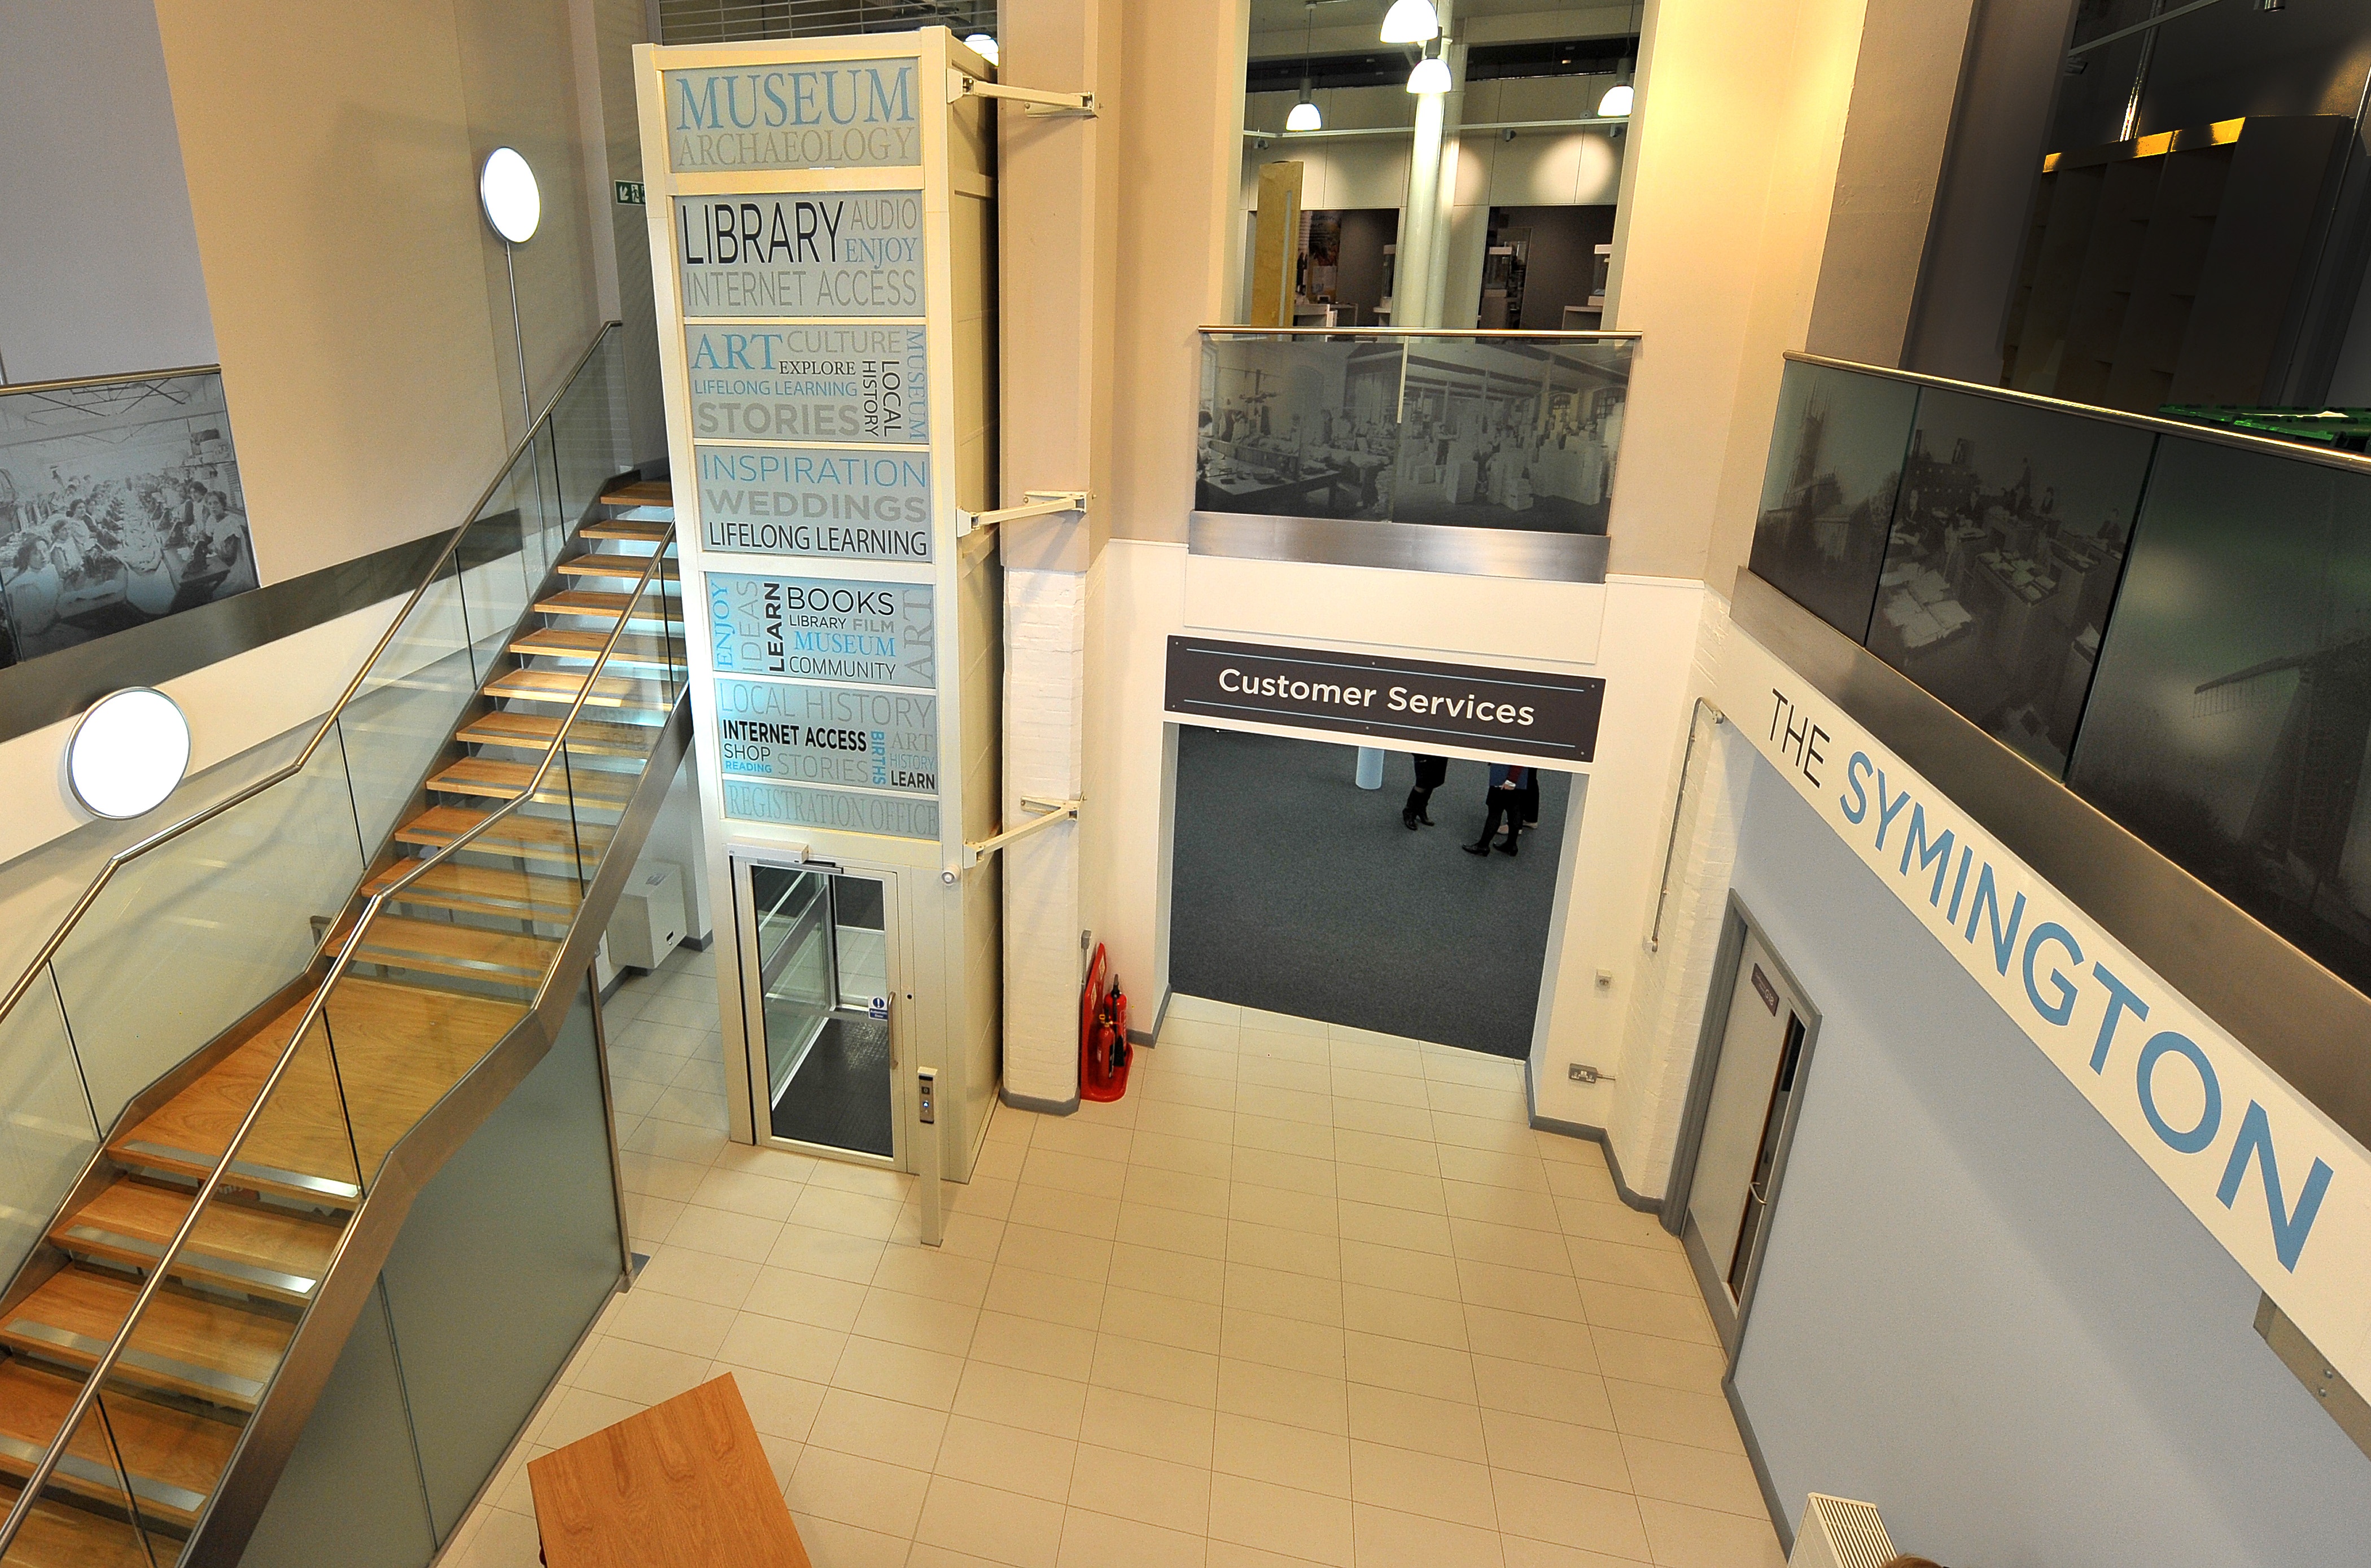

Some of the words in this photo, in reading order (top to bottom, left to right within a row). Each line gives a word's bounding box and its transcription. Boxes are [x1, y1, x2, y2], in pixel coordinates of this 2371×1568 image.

[676, 67, 915, 131] MUSEUM
[679, 126, 915, 167] ARCHAEOLOGY
[681, 200, 845, 265] LIBRARY
[850, 198, 917, 231] AUDIO
[845, 237, 917, 269] ENJOY
[686, 270, 807, 306] INTERNET
[817, 269, 917, 306] ACCESS
[692, 333, 782, 370] ART
[786, 330, 901, 354] CULTURE
[778, 360, 857, 376] EXPLORE
[905, 329, 926, 439] MUSEUM
[694, 379, 771, 395] LIFELONG
[775, 380, 858, 396] LEARNING
[862, 360, 879, 437] HISTORY
[881, 360, 902, 438] LOCAL
[697, 402, 860, 436] STORIES
[702, 454, 926, 488] INSPIRATION
[705, 488, 927, 523] WEDDINGS
[709, 522, 810, 550] LIFELONG
[816, 527, 927, 557] LEARNING
[786, 586, 895, 616] BOOKS
[711, 581, 734, 668] ENJOY
[738, 581, 763, 671] IDEAS
[763, 581, 785, 672] LEARN
[789, 614, 847, 630] LIBRARY
[852, 617, 895, 633] FILM
[904, 589, 934, 684] ART
[794, 630, 896, 658] MUSEUM
[789, 655, 896, 680] COMMUNITY
[720, 684, 795, 717] LOCAL
[806, 688, 933, 728] HISTORY
[1218, 668, 1377, 708] Customer
[1387, 686, 1535, 726] Services
[723, 719, 800, 746] INTERNET
[804, 727, 868, 752] ACCESS
[723, 743, 772, 762] SHOP
[890, 732, 934, 752] ART
[725, 760, 772, 774] READING
[778, 754, 868, 783] STORIES
[870, 730, 886, 785] BIRTHS
[889, 753, 934, 771] HISTORY
[890, 769, 936, 790] LEARN
[729, 785, 867, 827] REGISTRATION
[871, 800, 938, 836] OFFICE
[1771, 687, 1831, 789] THE
[1839, 751, 2335, 1274] SYMINGTON
